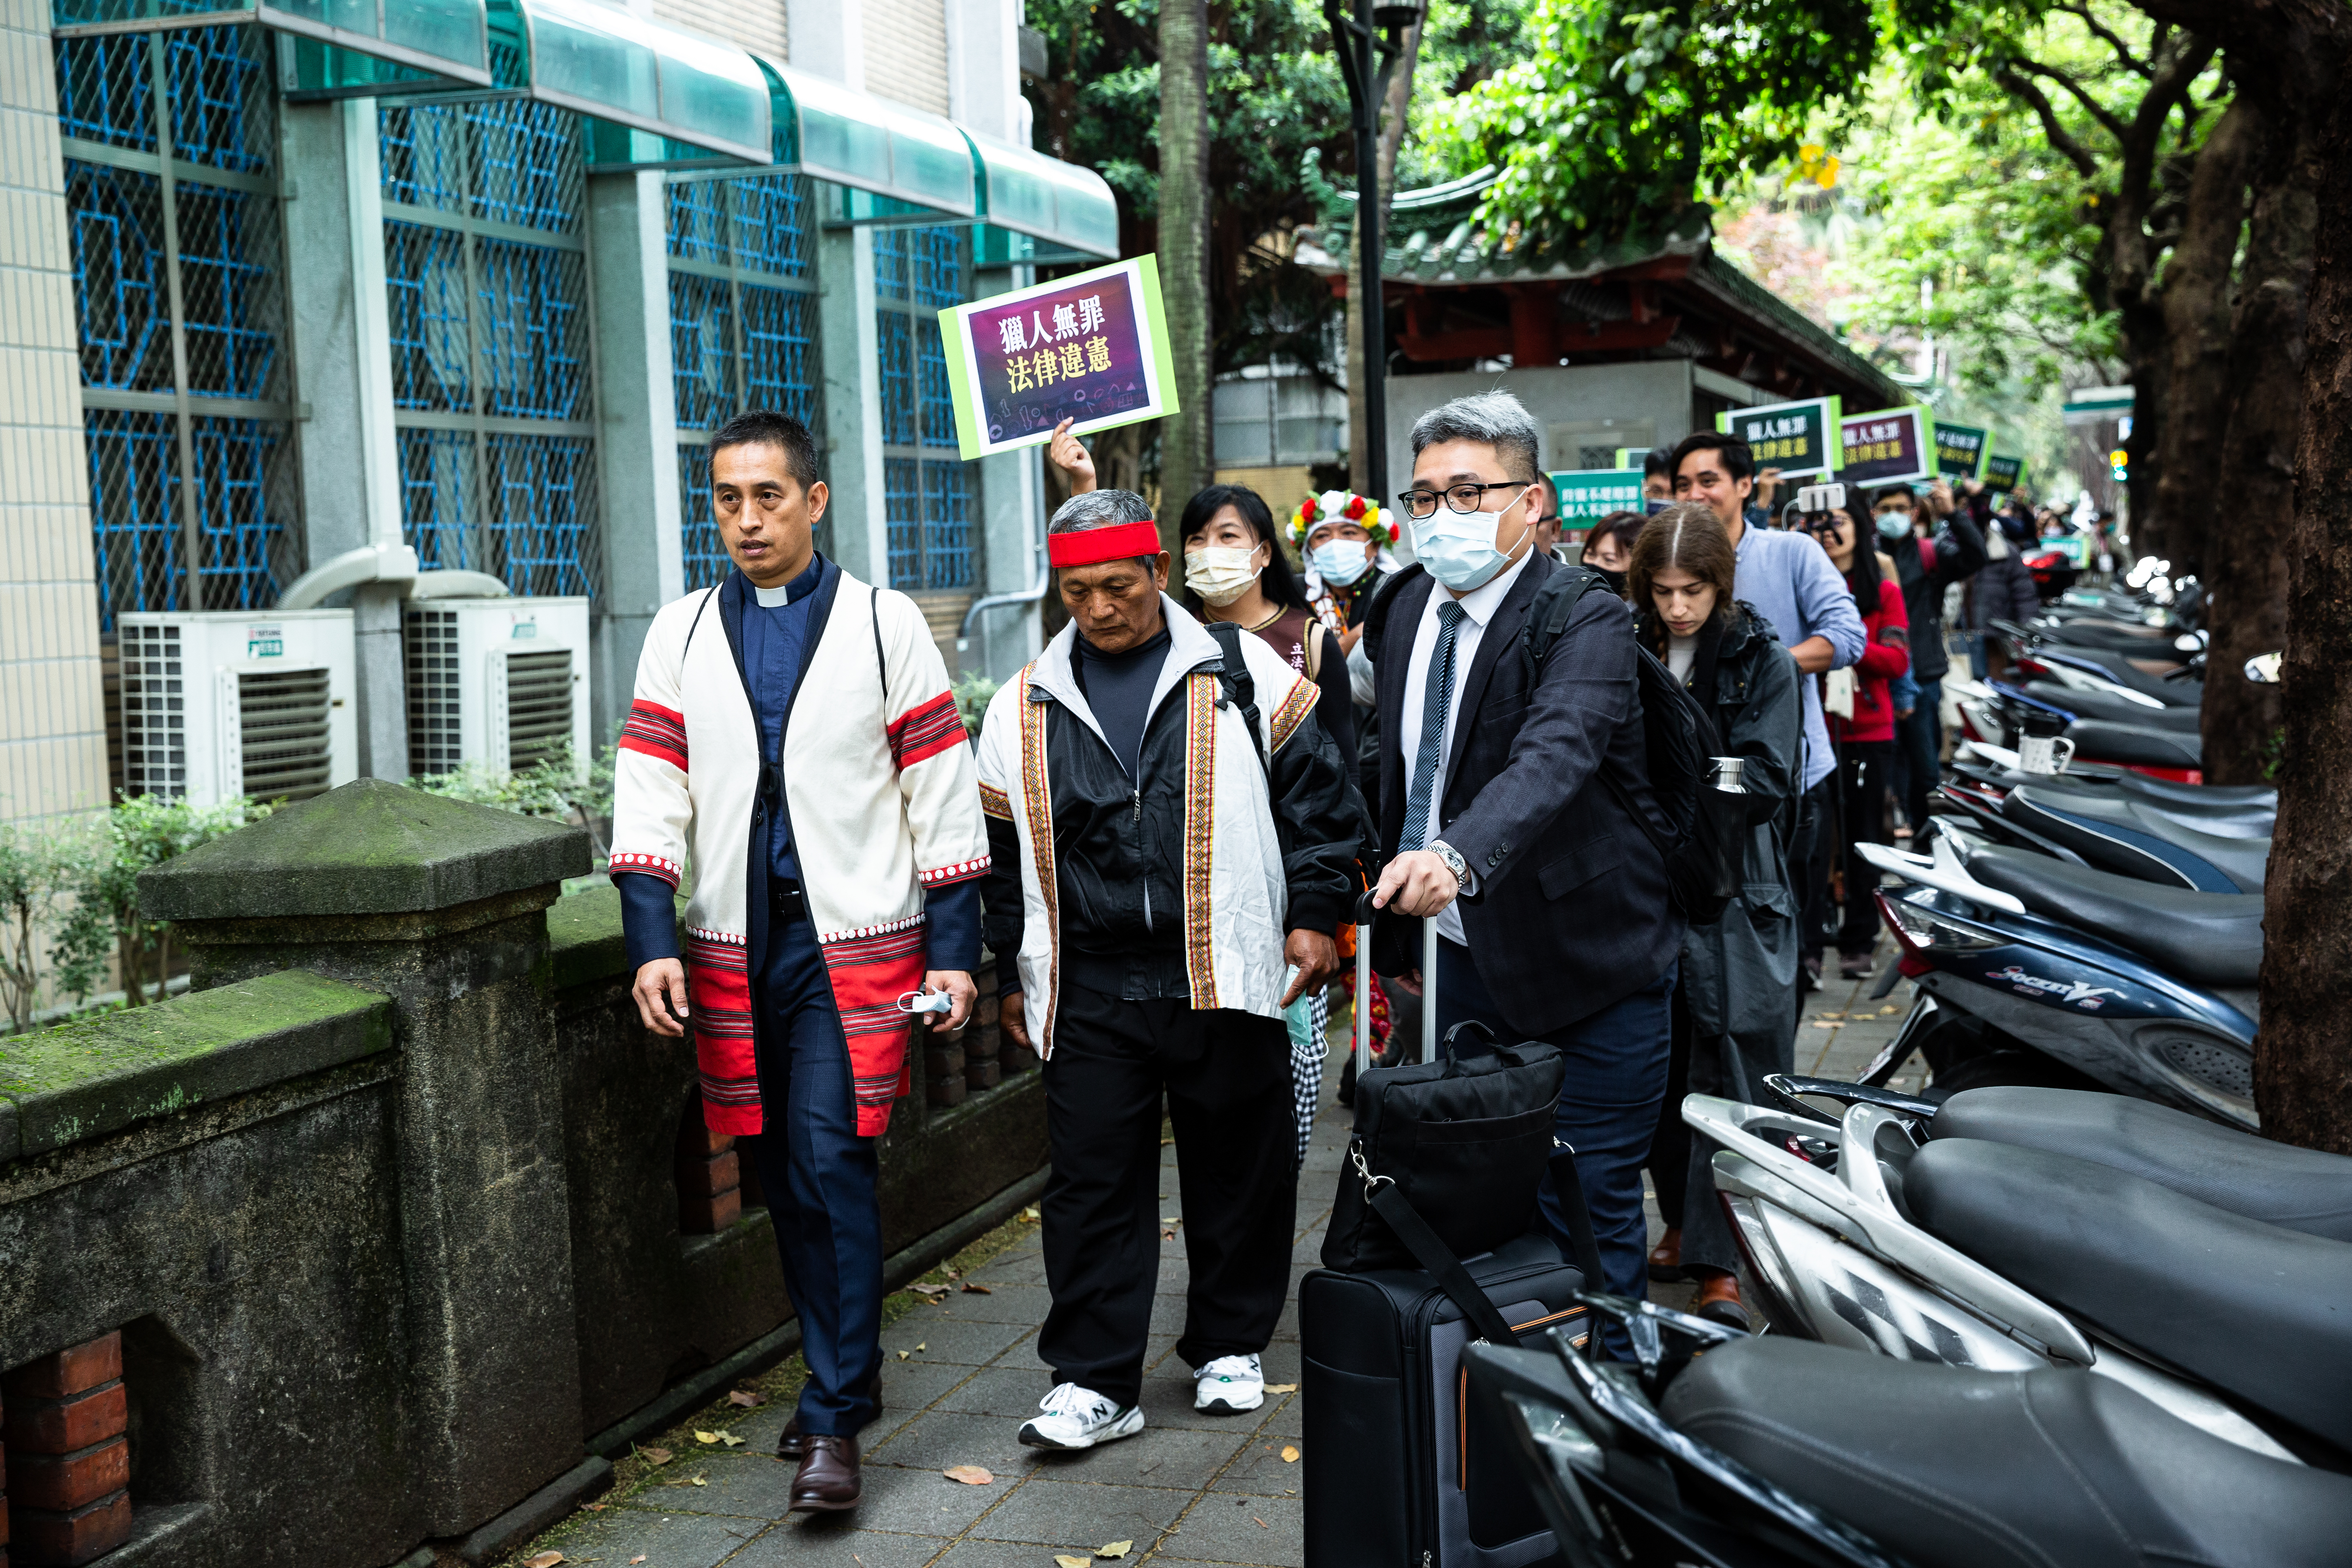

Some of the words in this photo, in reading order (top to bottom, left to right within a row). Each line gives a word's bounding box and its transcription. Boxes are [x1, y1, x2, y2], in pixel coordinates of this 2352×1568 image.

[998, 294, 1106, 354] 獵人無罪
[1006, 335, 1112, 394] 法律違憲
[1746, 415, 1808, 442] 獵人無罪
